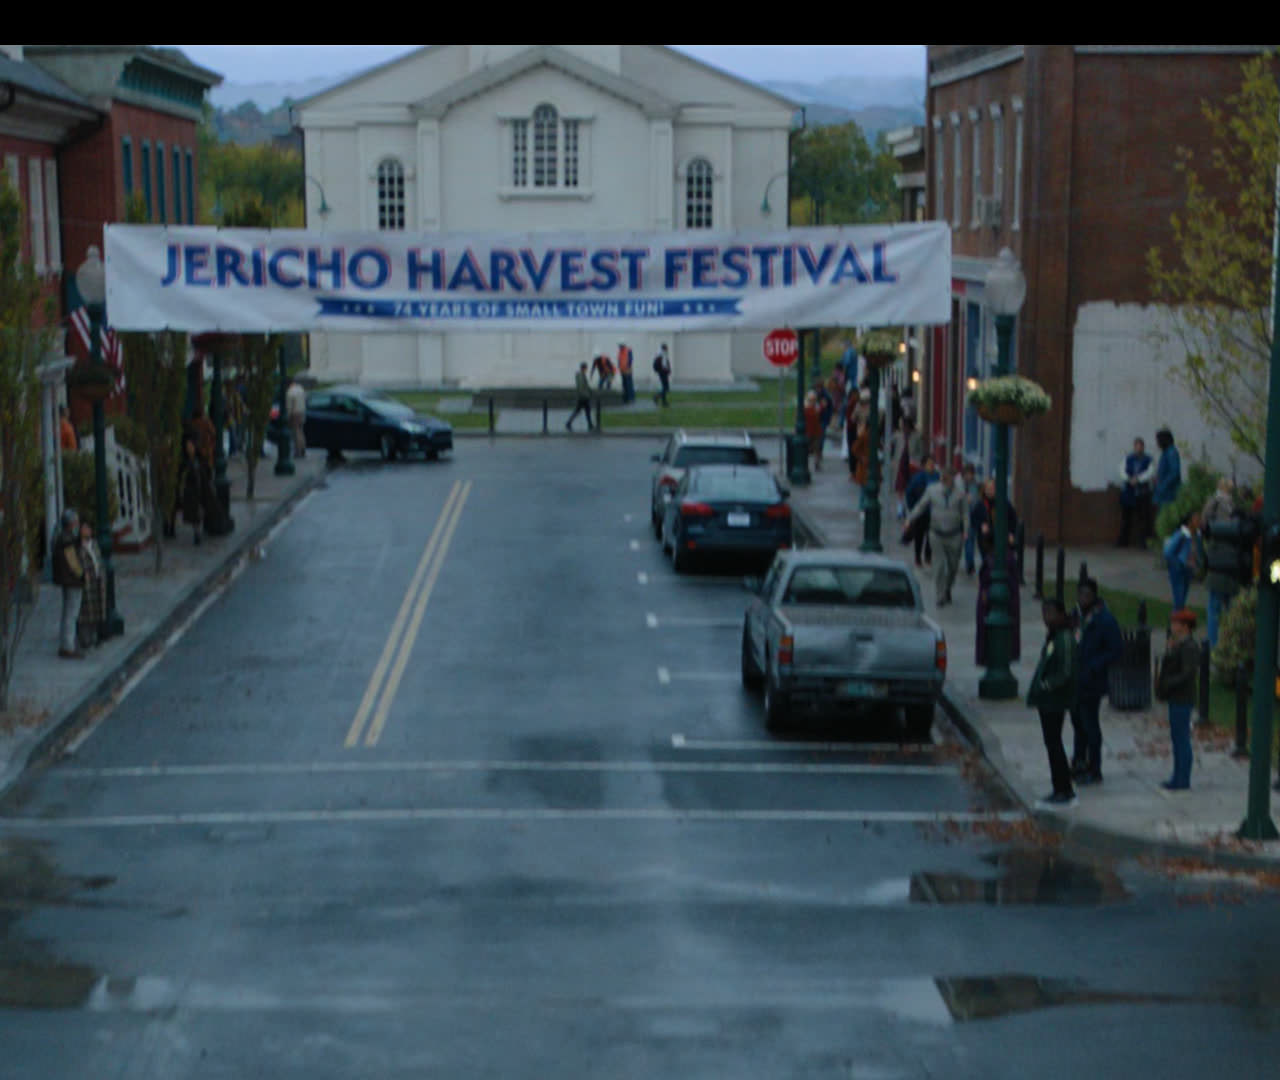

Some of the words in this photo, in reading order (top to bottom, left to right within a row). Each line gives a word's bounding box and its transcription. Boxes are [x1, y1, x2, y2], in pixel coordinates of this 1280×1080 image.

[161, 243, 392, 290] JERICHO
[407, 246, 651, 293] HARVEST
[664, 241, 899, 289] FESTIVAL
[420, 302, 471, 318] YEARS
[477, 303, 497, 318] OF
[505, 303, 559, 318] SMALL
[567, 302, 619, 318] TOWN
[625, 300, 665, 317] FUN!
[766, 338, 799, 357] STOP
